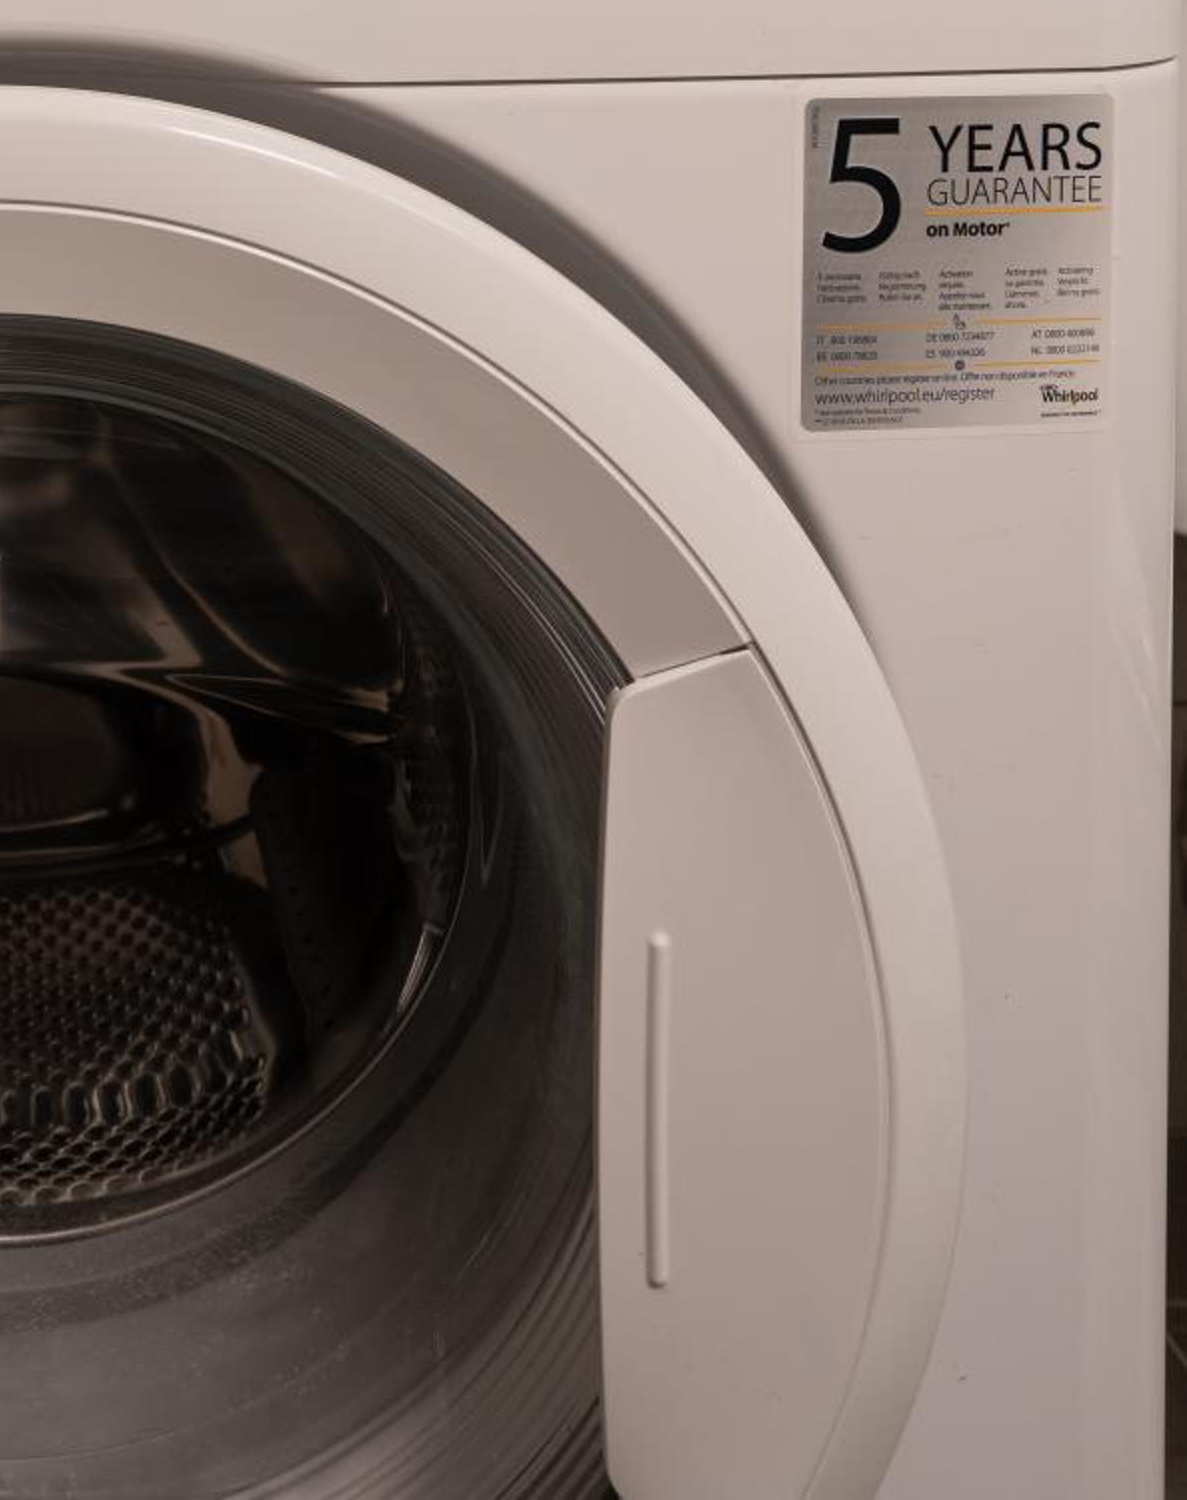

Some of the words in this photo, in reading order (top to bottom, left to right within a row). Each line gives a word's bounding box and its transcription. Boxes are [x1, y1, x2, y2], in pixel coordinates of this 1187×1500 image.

[928, 121, 1102, 173] YEARS
[822, 117, 902, 253] 5
[926, 175, 1102, 206] GUARANTEE
[926, 223, 949, 238] on
[814, 387, 995, 405] www.whirlpool.eu/register
[1041, 386, 1099, 405] Whirlpool
